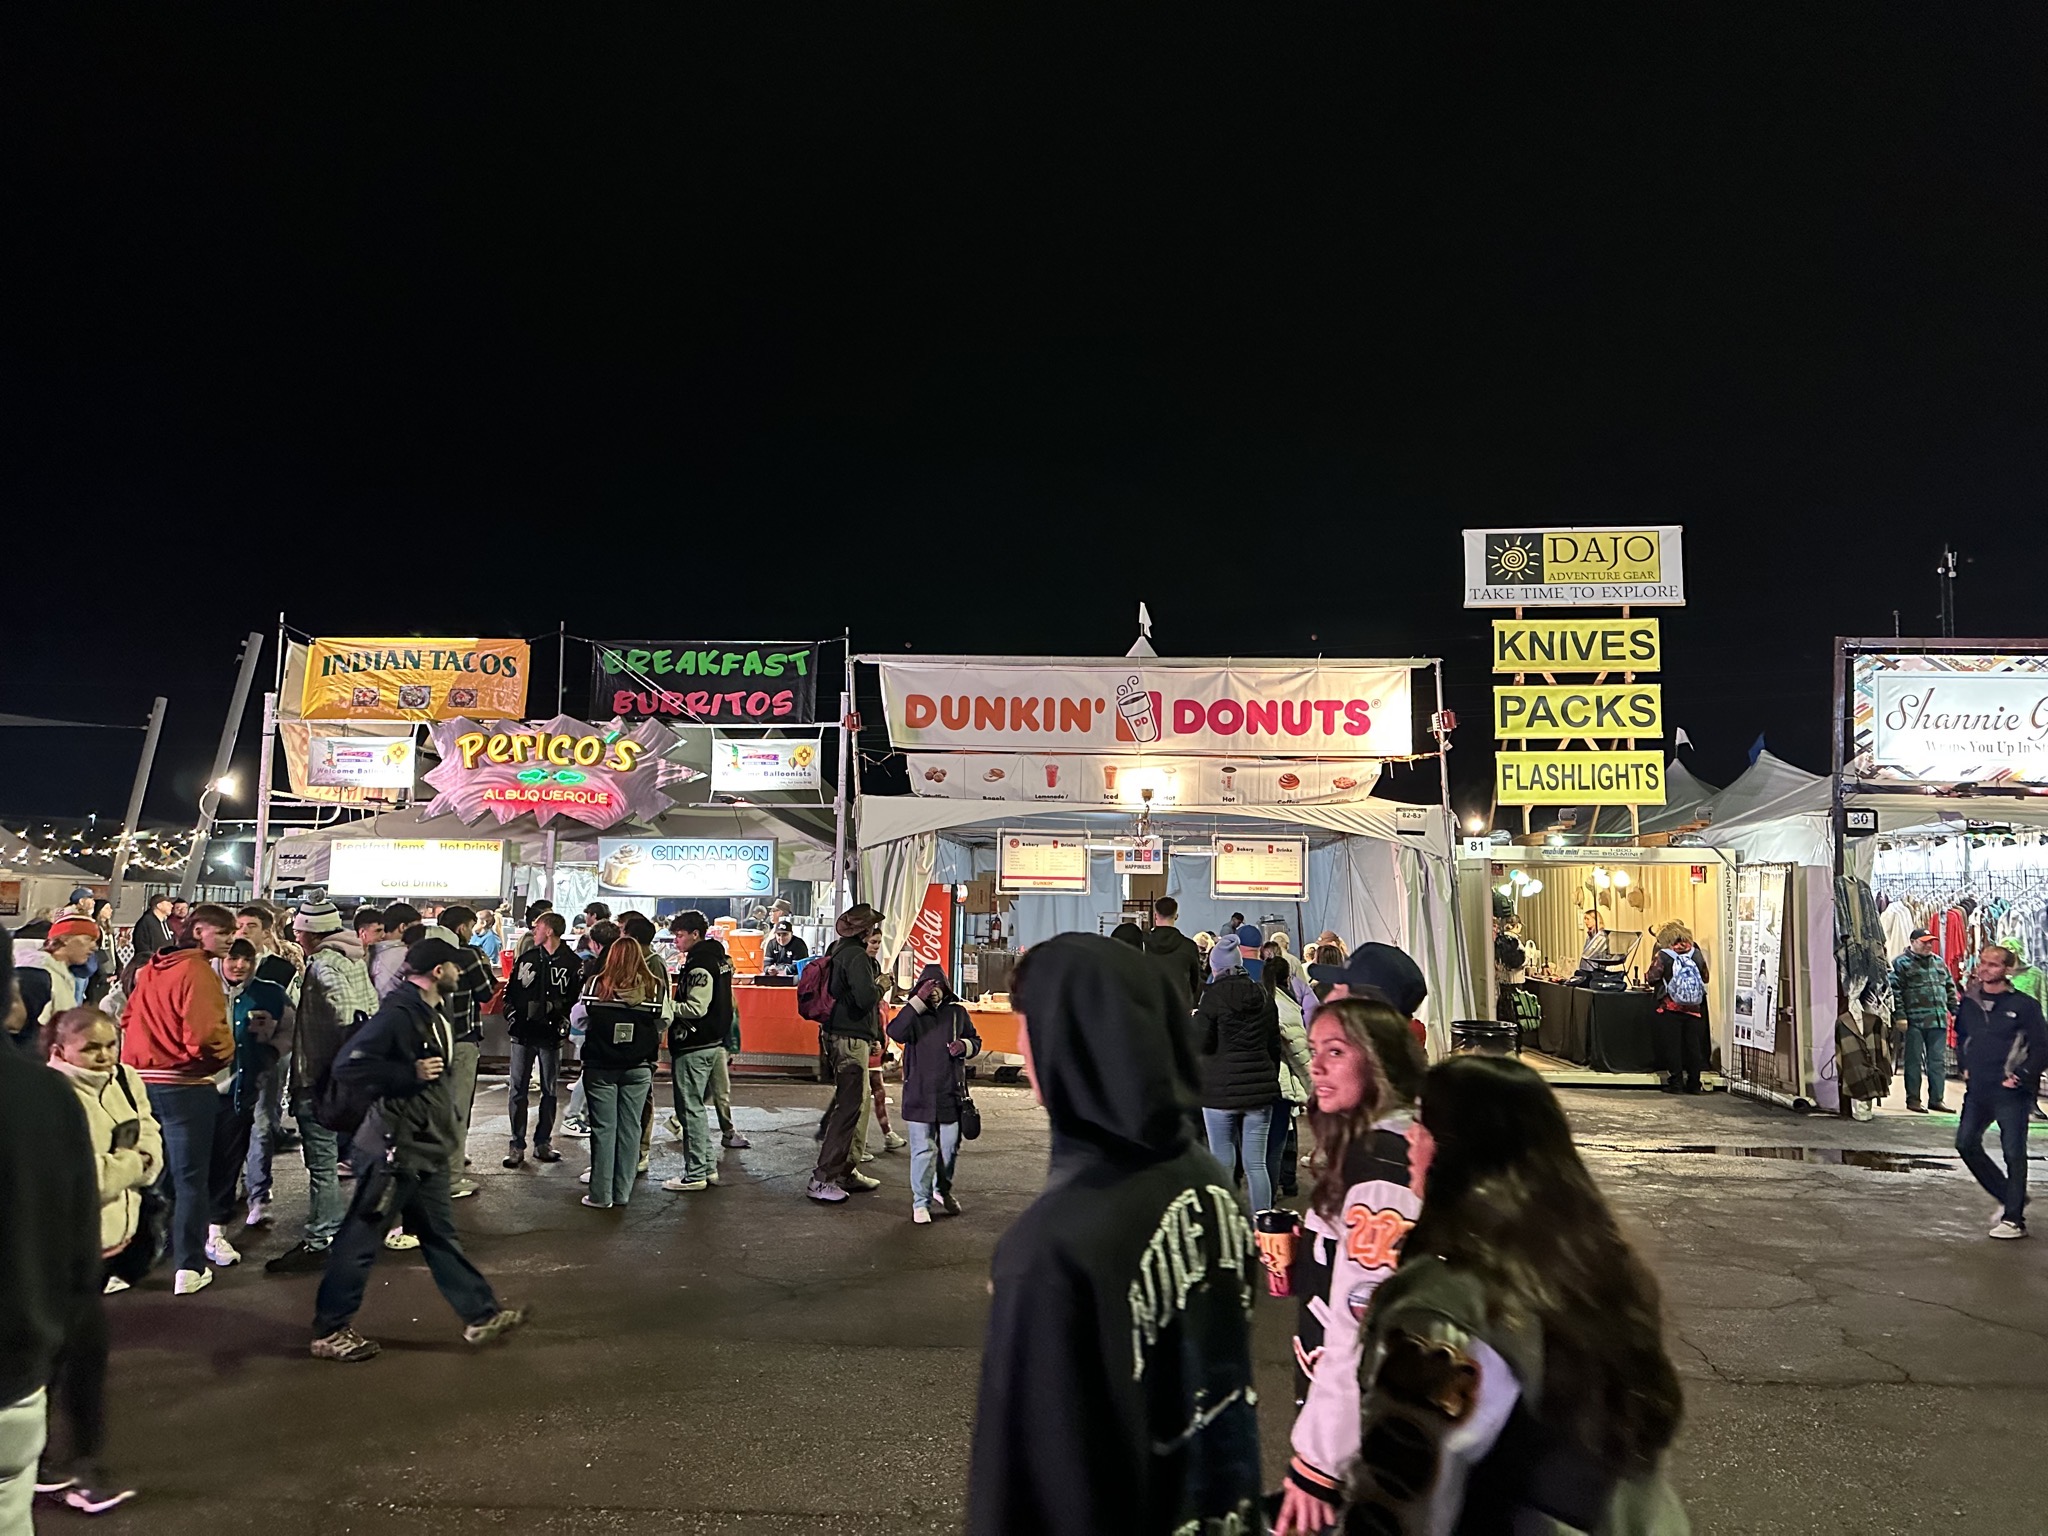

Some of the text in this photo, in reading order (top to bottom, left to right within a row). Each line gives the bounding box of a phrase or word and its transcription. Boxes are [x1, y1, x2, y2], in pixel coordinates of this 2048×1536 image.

[1548, 536, 1655, 570] DAJO
[1548, 570, 1656, 581] ADVENTURE GEAR
[1469, 585, 1679, 600] TAKE TIME TO EXPLORE
[1498, 629, 1656, 661] KNIVES
[320, 650, 518, 679] INDIAN TACOS
[602, 649, 811, 677] BREAKFAST
[612, 689, 794, 717] BURRITOS
[1499, 694, 1656, 728] PACKS
[1885, 687, 2023, 731] Shannie
[905, 694, 1372, 736] DUNKIN' DONUTS
[1133, 716, 1149, 728] DD
[1925, 740, 1966, 754] Wps
[1969, 740, 1994, 753] You
[1997, 740, 2015, 757] Up
[2018, 741, 2031, 753] In
[1502, 763, 1660, 791] FLASHLIGHTS
[482, 788, 609, 804] ALBUQUERQUE
[1852, 812, 1869, 825] 80
[336, 842, 500, 852] Breakfast Items Hot Drinks
[651, 845, 769, 861] CINNAMON
[1470, 841, 1484, 851] 81
[1541, 847, 1565, 855] mobile
[381, 879, 448, 888] Cold Drinks
